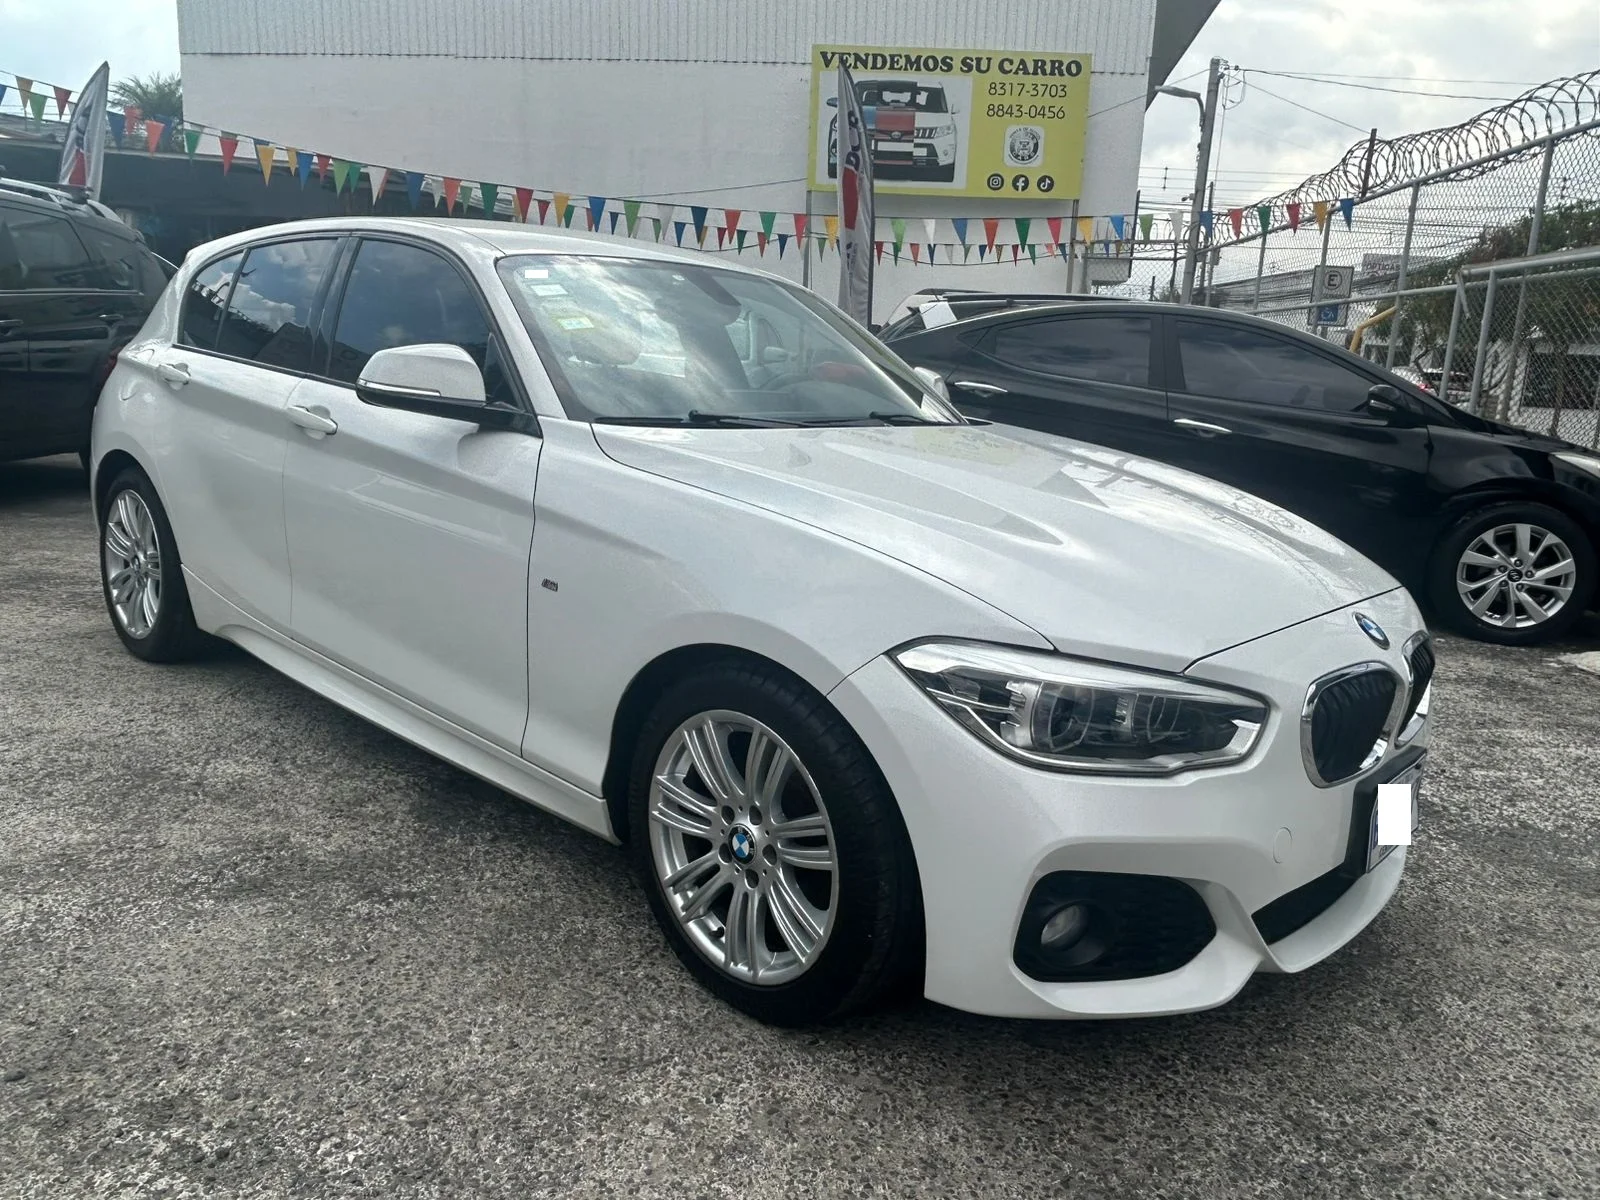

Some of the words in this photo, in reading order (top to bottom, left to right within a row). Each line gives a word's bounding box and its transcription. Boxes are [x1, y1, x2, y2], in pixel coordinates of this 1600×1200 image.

[820, 50, 954, 73] VENDEMOS
[960, 56, 993, 75] SU
[998, 58, 1083, 78] CARRO
[987, 81, 1067, 98] 8317-3703
[986, 103, 1066, 120] 8843-0456
[1327, 273, 1338, 287] E
